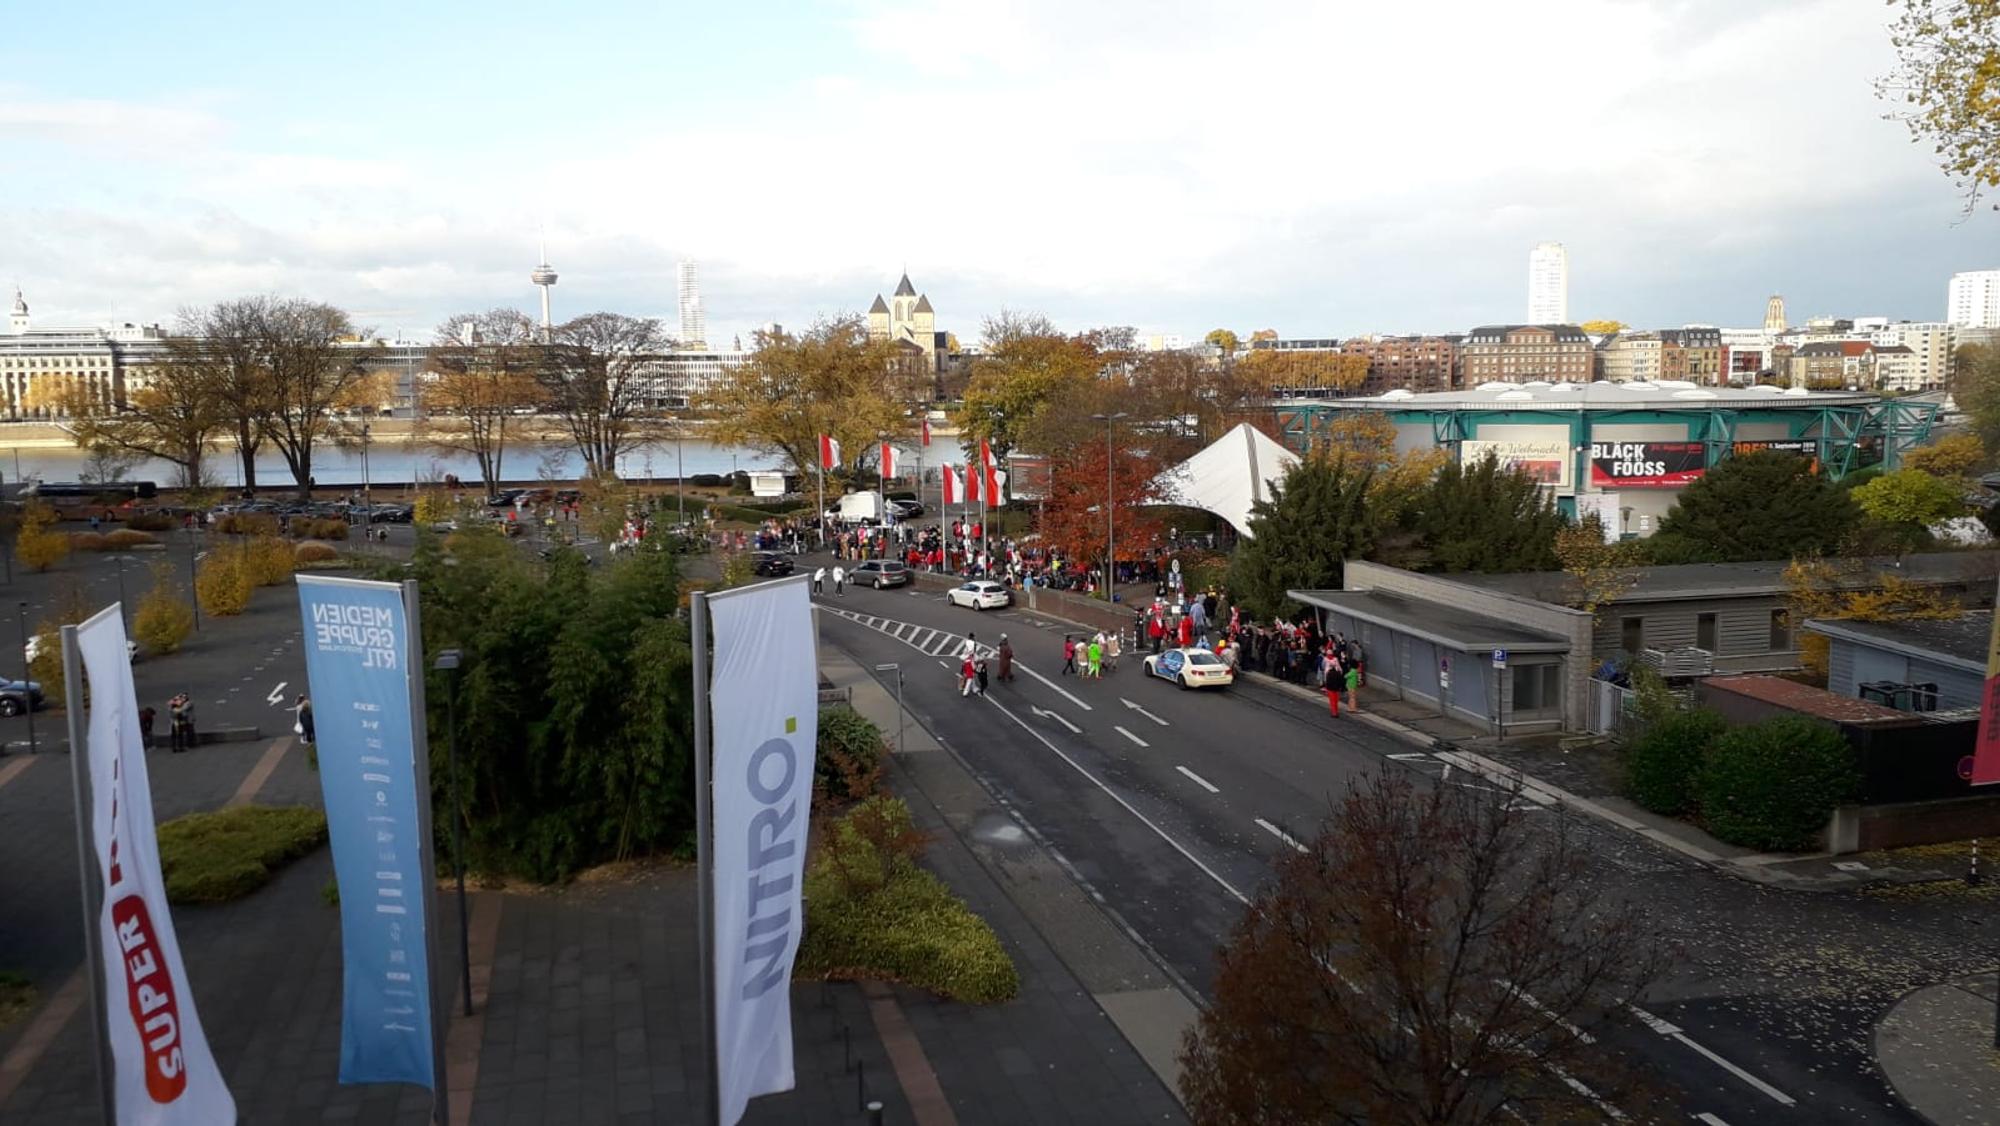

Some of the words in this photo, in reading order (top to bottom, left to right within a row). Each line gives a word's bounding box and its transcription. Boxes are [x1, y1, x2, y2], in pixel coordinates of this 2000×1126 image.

[1591, 441, 1645, 459] BLÄCK
[1613, 458, 1666, 476] FÖÖSS
[743, 736, 797, 1002] NITRO
[118, 915, 185, 1080] SUPER
